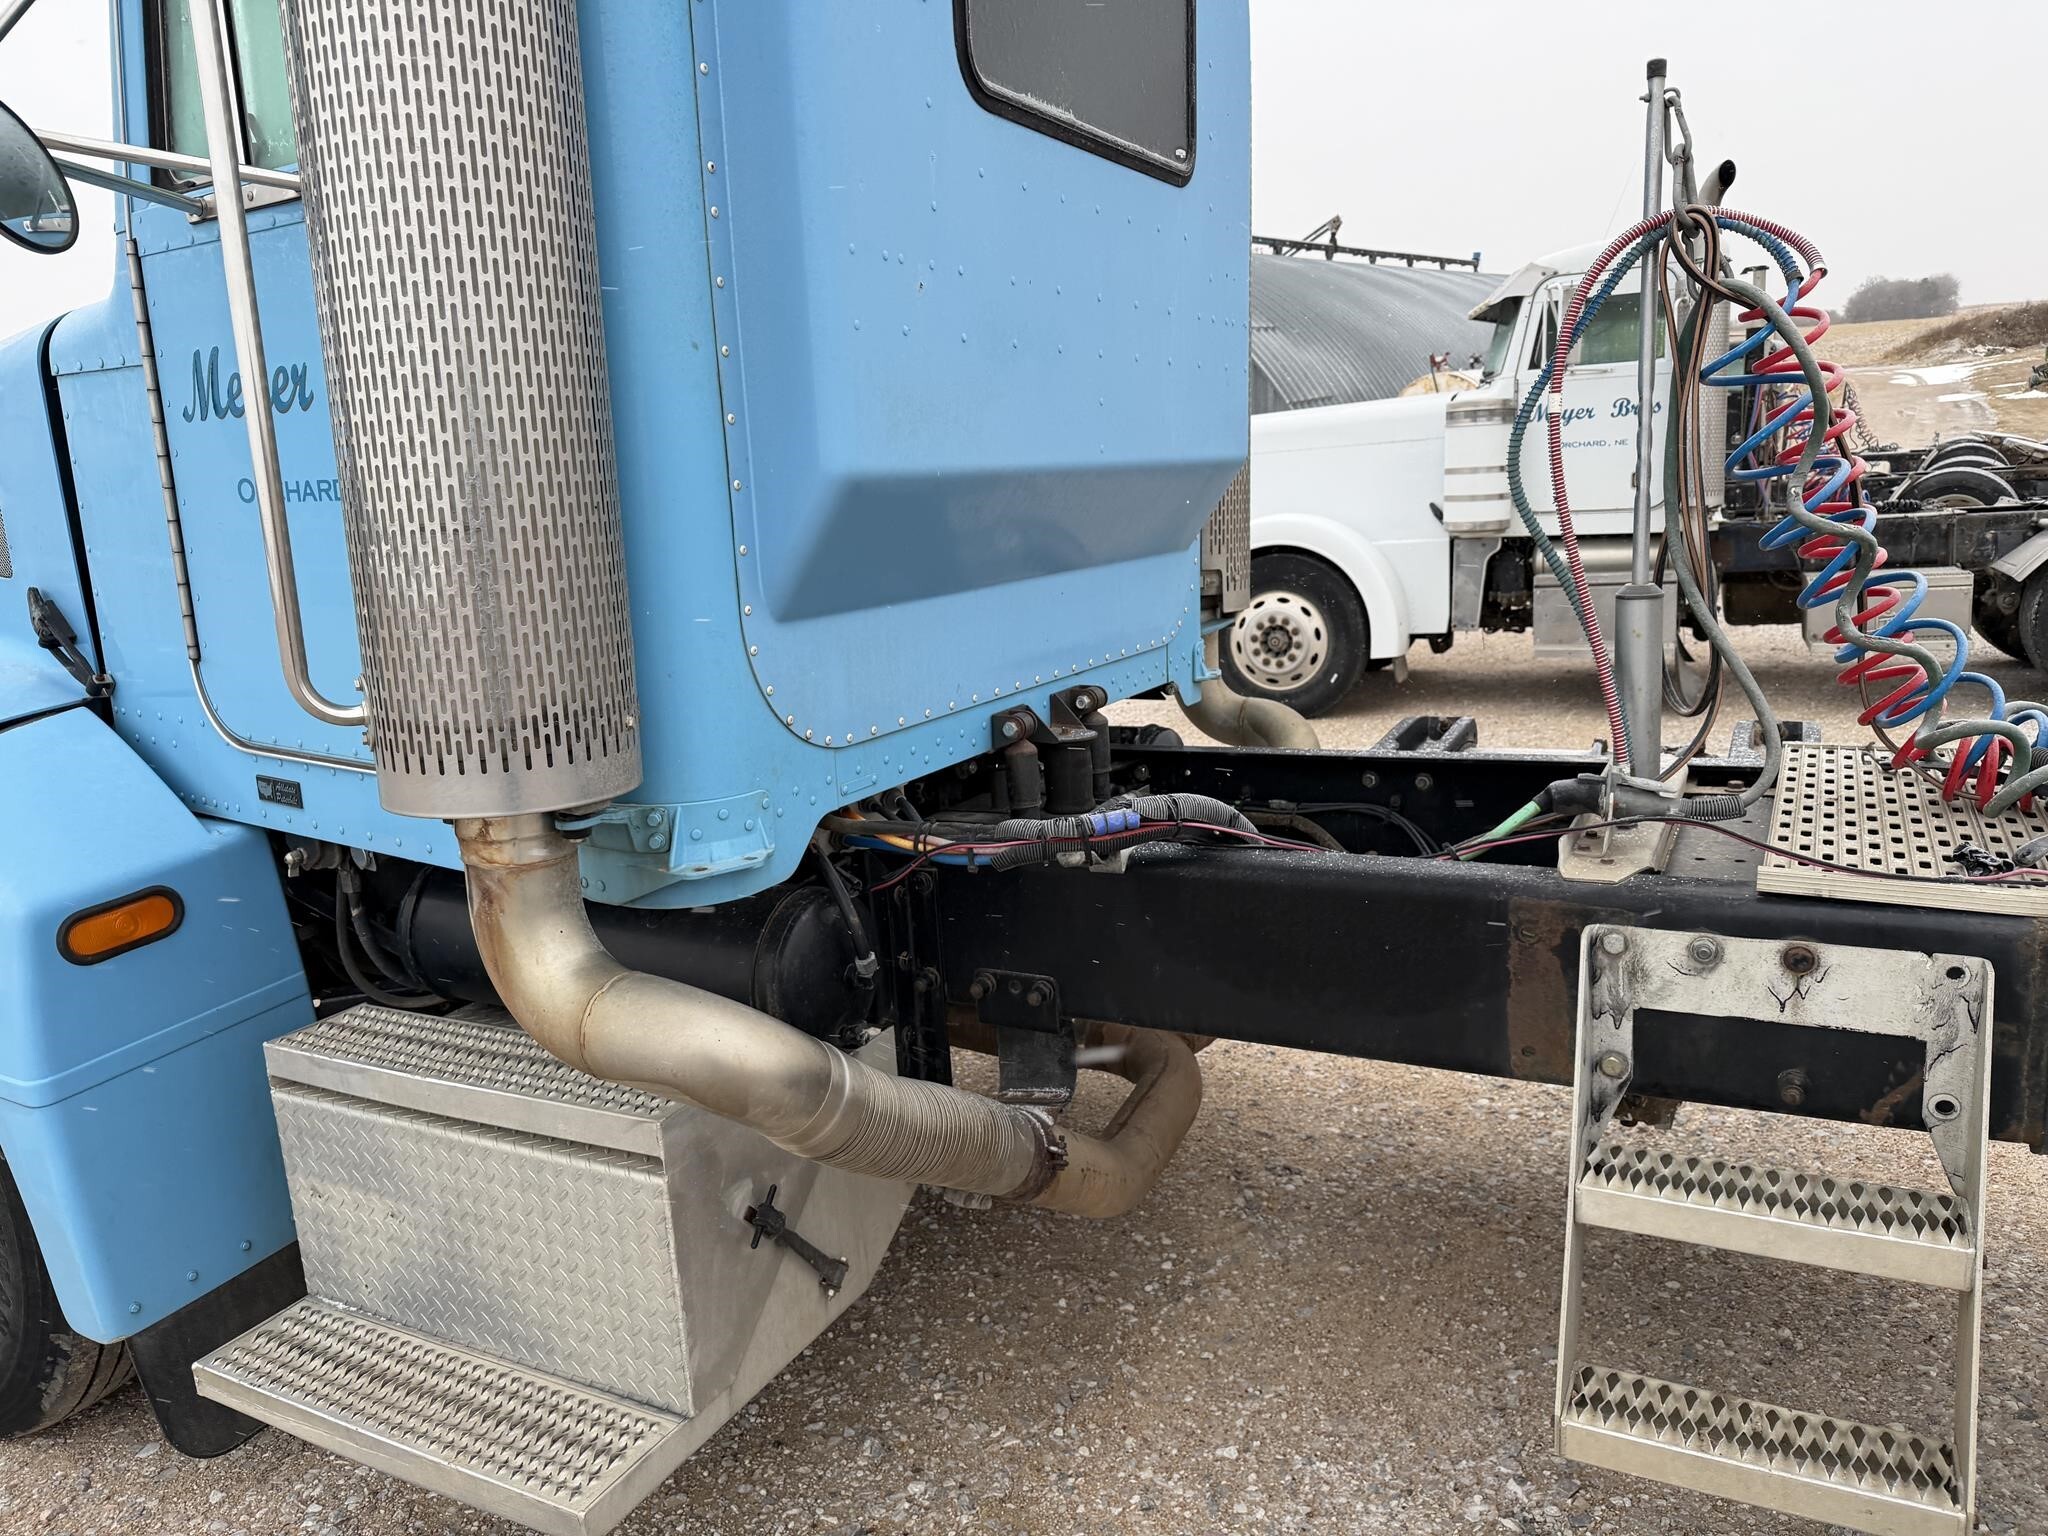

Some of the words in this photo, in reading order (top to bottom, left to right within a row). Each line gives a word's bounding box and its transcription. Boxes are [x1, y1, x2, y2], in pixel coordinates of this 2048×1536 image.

[182, 346, 315, 424] Meer
[1529, 402, 1596, 427] Myer
[1610, 397, 1662, 418] Brs
